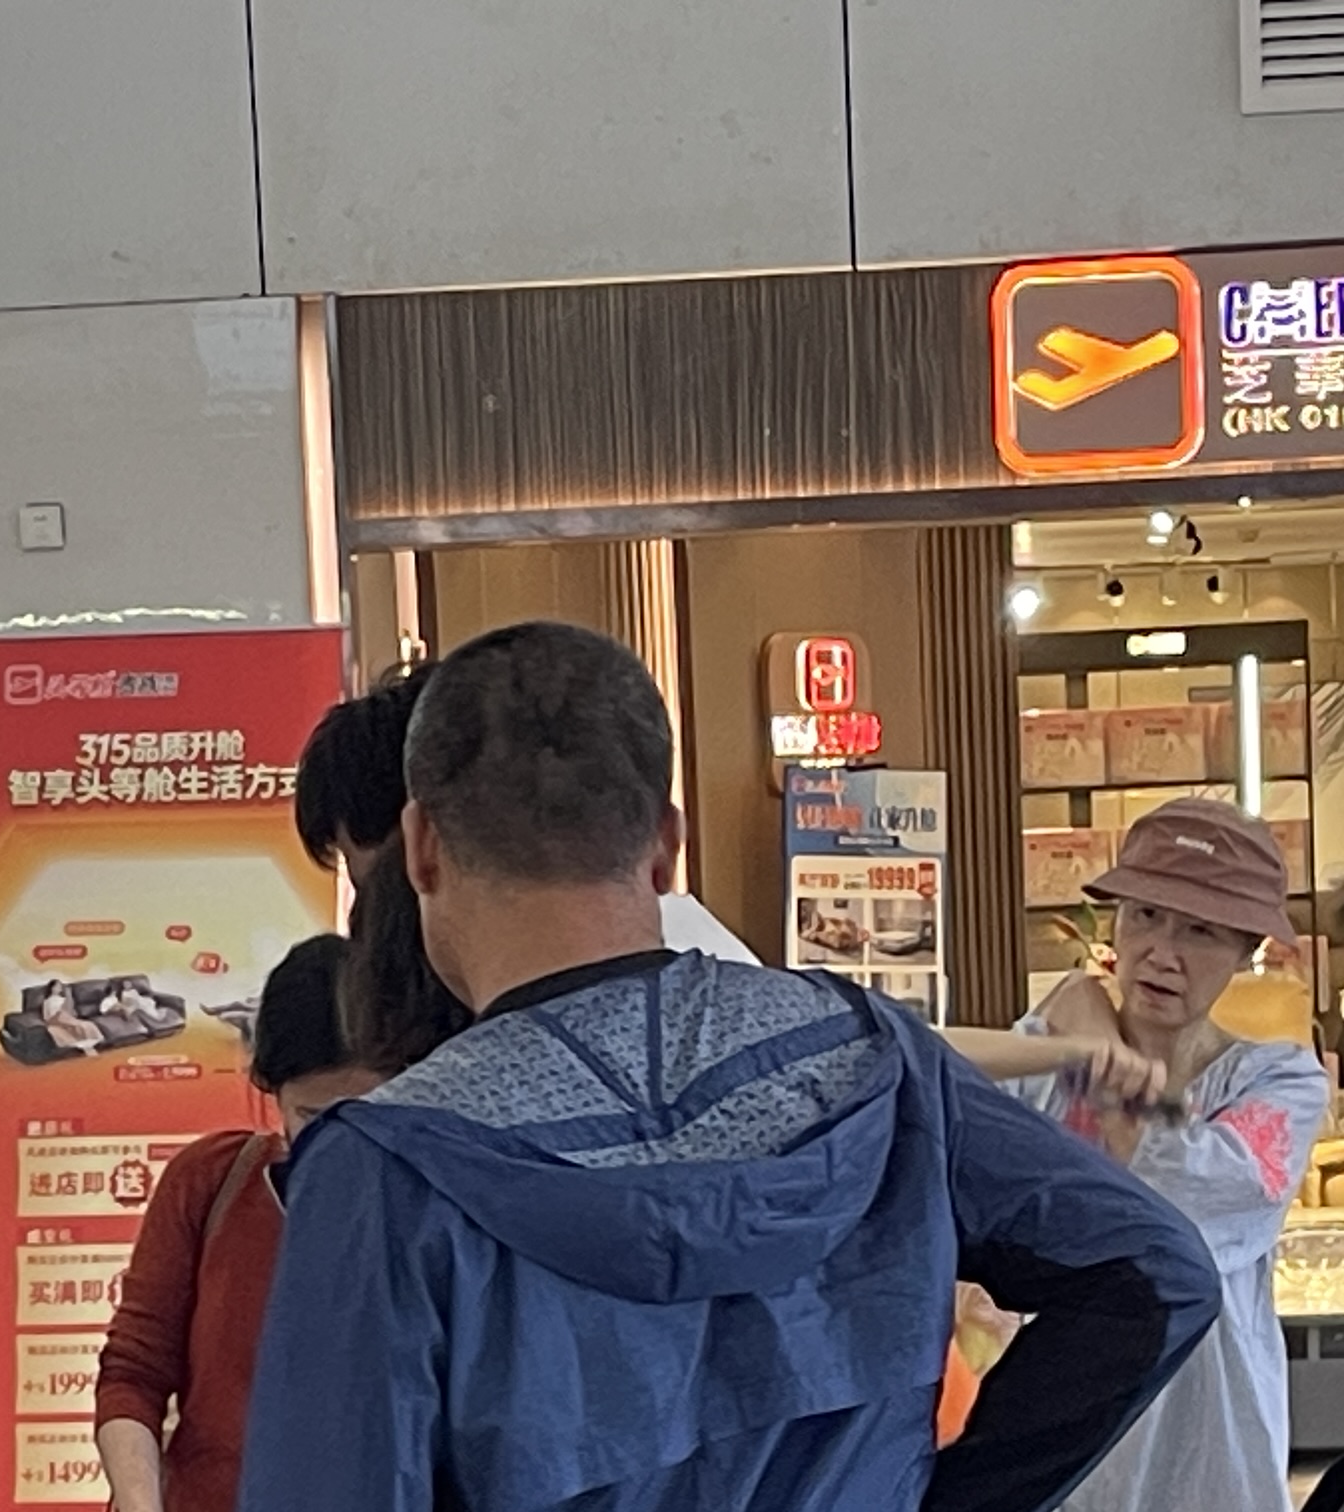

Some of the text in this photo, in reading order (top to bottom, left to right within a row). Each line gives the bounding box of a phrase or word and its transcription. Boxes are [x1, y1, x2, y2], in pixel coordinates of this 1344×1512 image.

[75, 728, 246, 767] 315品质升舱
[29, 1274, 123, 1306] 买满即
